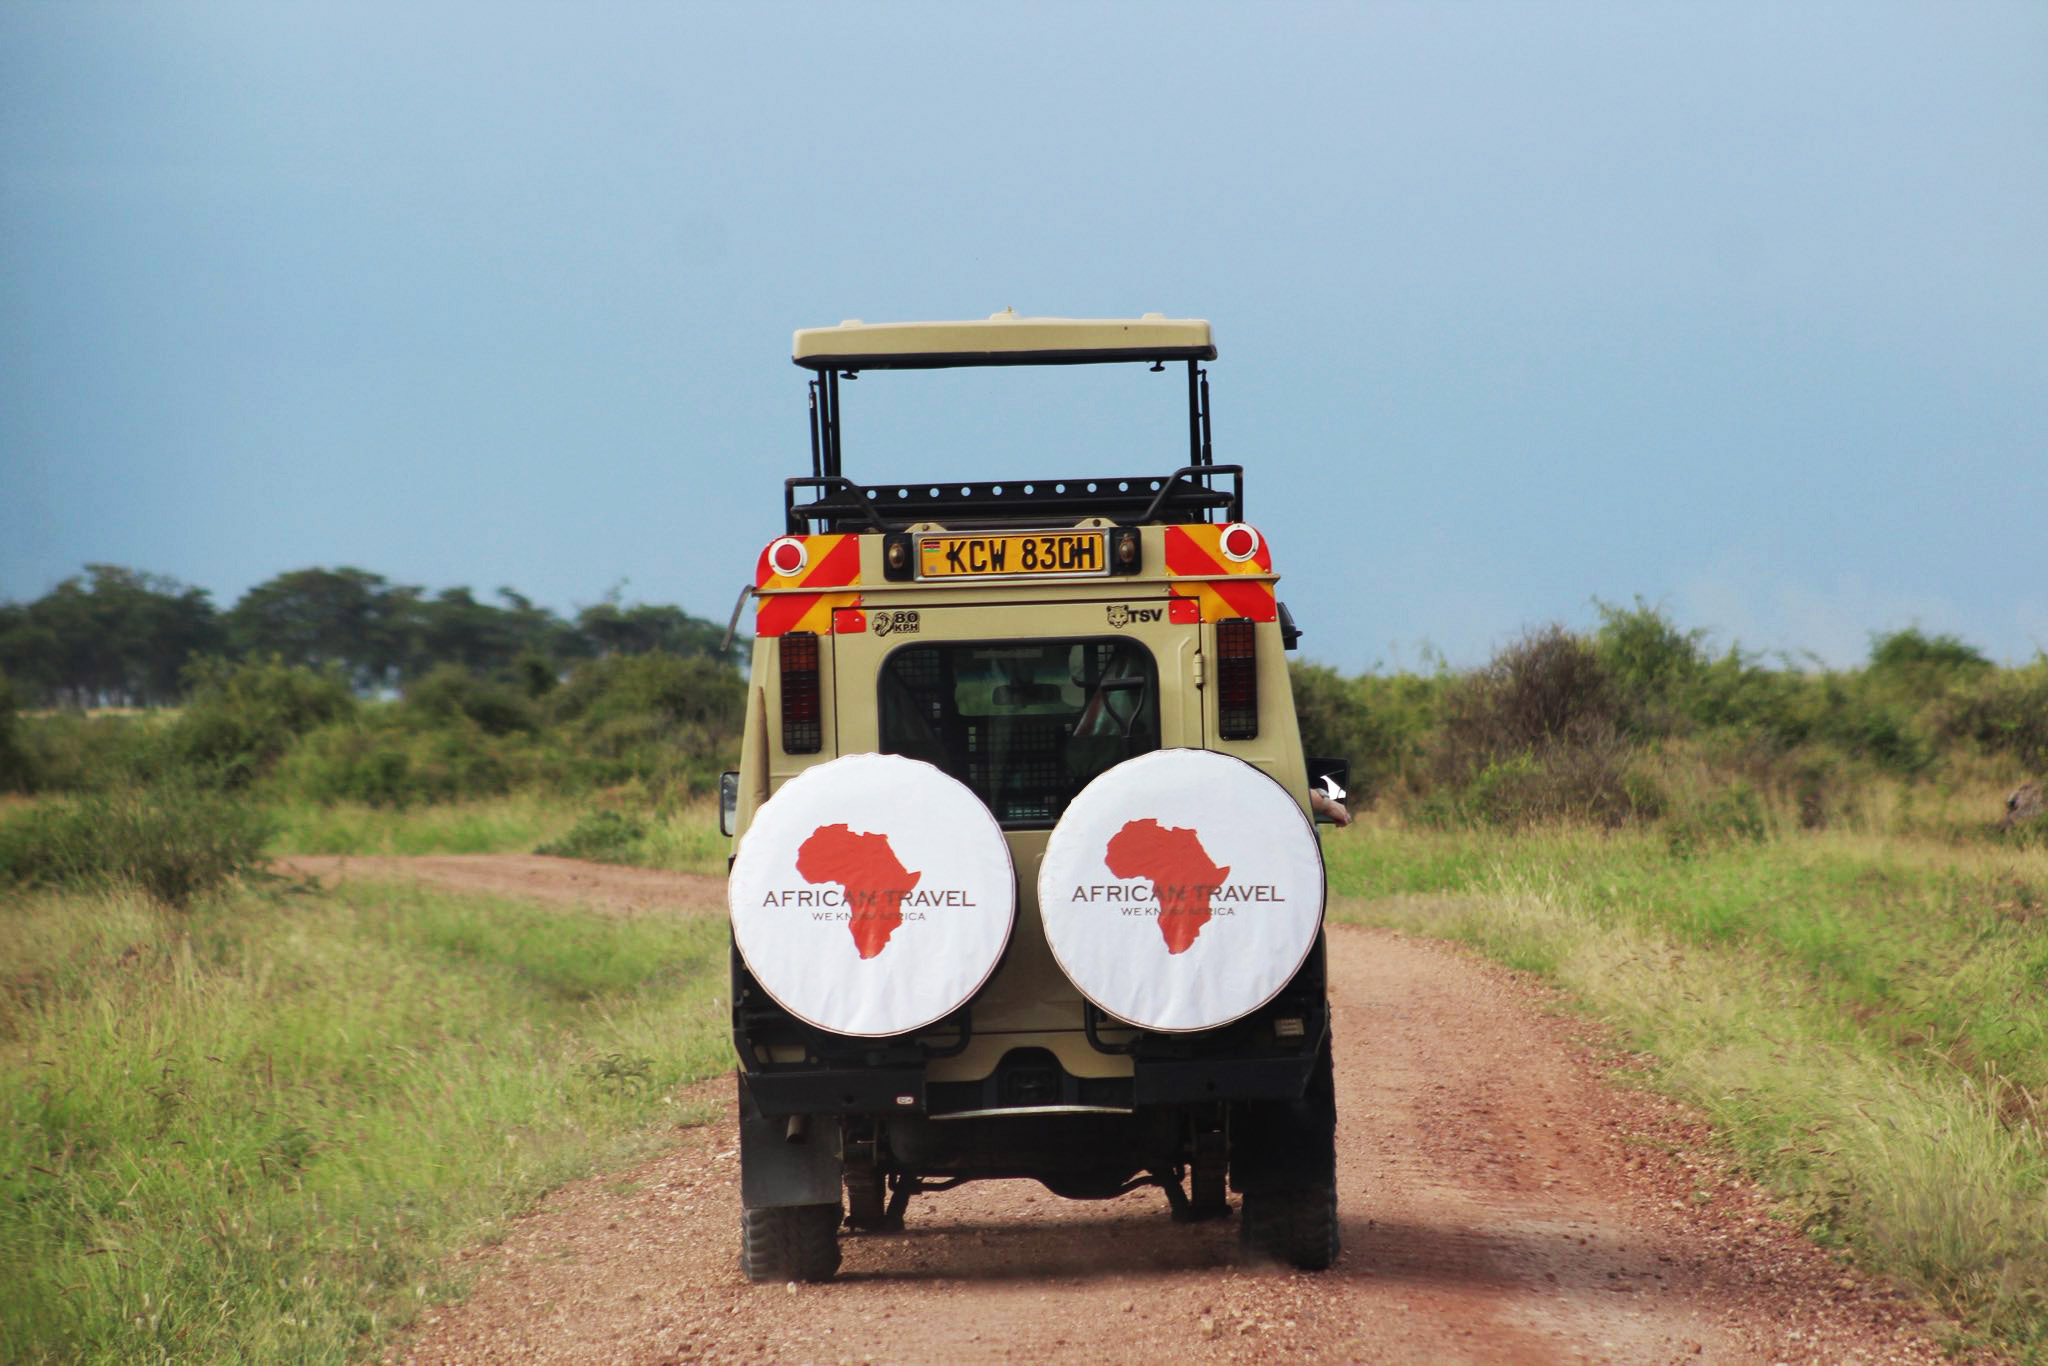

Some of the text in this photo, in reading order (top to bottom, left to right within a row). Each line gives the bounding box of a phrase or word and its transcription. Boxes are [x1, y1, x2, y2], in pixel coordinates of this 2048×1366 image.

[949, 539, 1007, 573] KCW
[894, 612, 918, 623] 80
[1128, 608, 1163, 623] TSV
[894, 624, 918, 632] KPH
[883, 890, 976, 907] TRAVEL
[1191, 885, 1286, 902] TRAVEL
[811, 912, 833, 921] WE
[1121, 907, 1142, 916] WE
